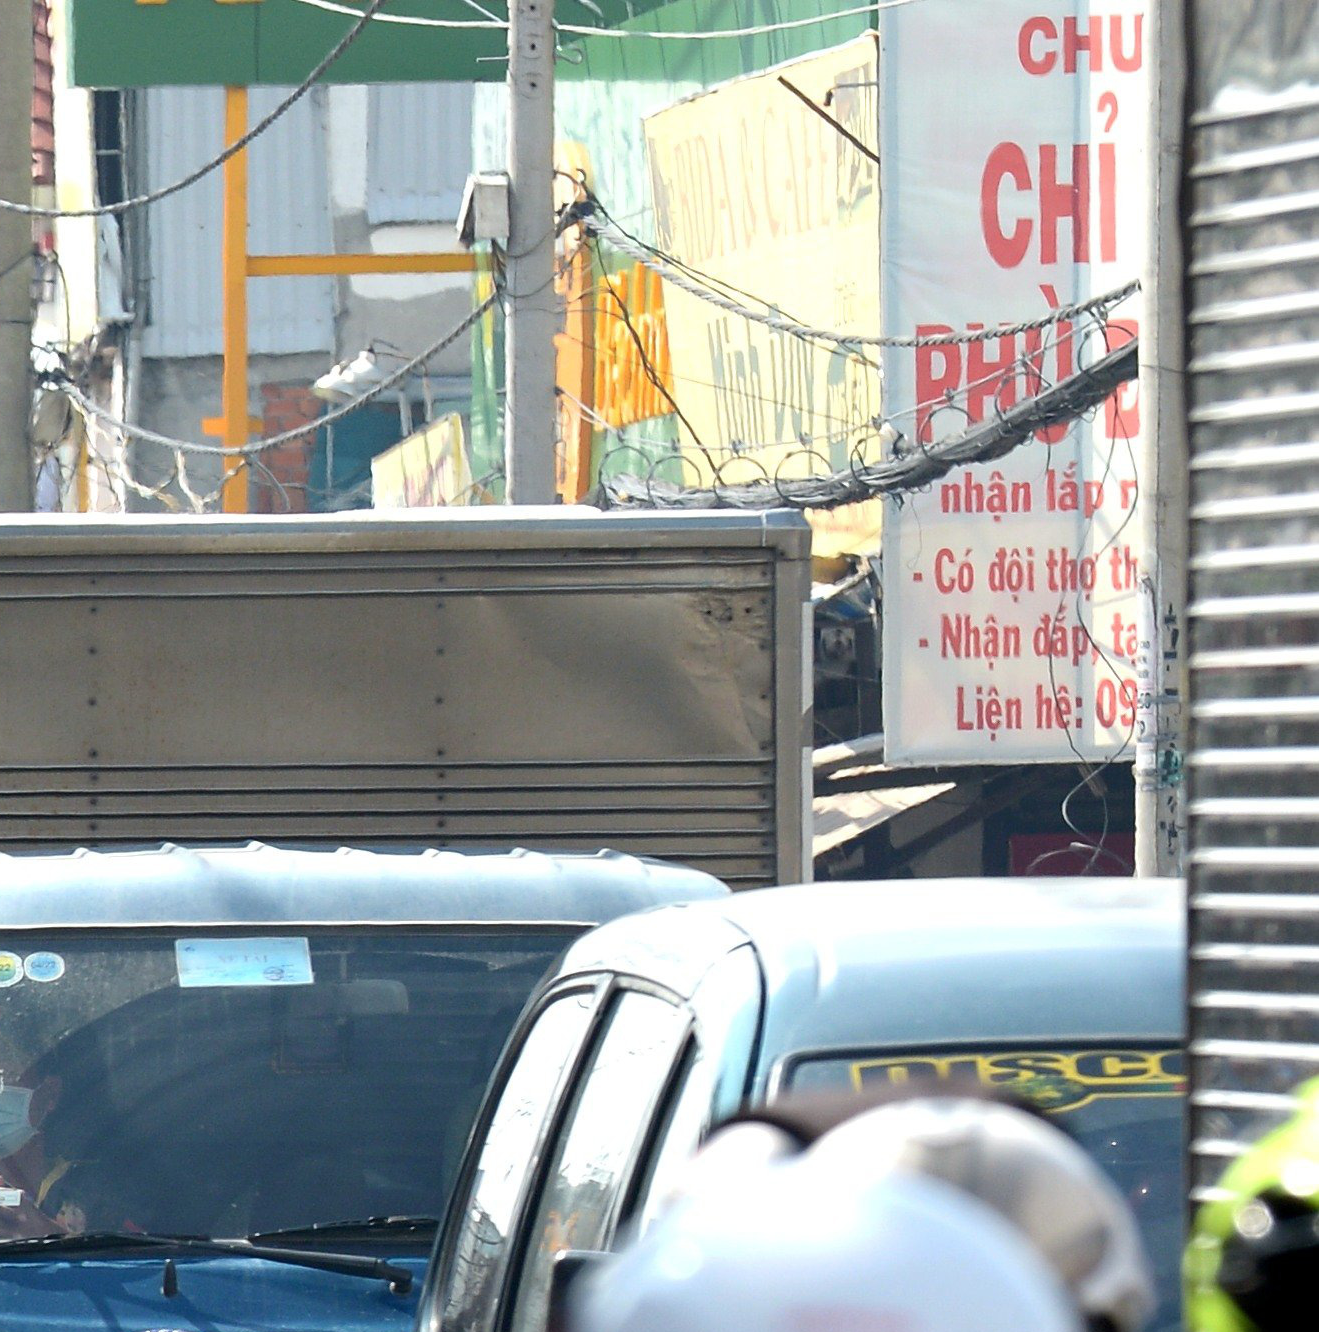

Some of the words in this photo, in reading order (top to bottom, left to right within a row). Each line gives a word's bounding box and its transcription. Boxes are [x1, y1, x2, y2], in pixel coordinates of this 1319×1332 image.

[980, 90, 1118, 269] CHỈ
[941, 470, 1032, 522] nhận
[934, 547, 975, 594] Có
[988, 546, 1035, 602] đội
[1046, 546, 1100, 602] thợ
[941, 613, 1021, 670] Nhận
